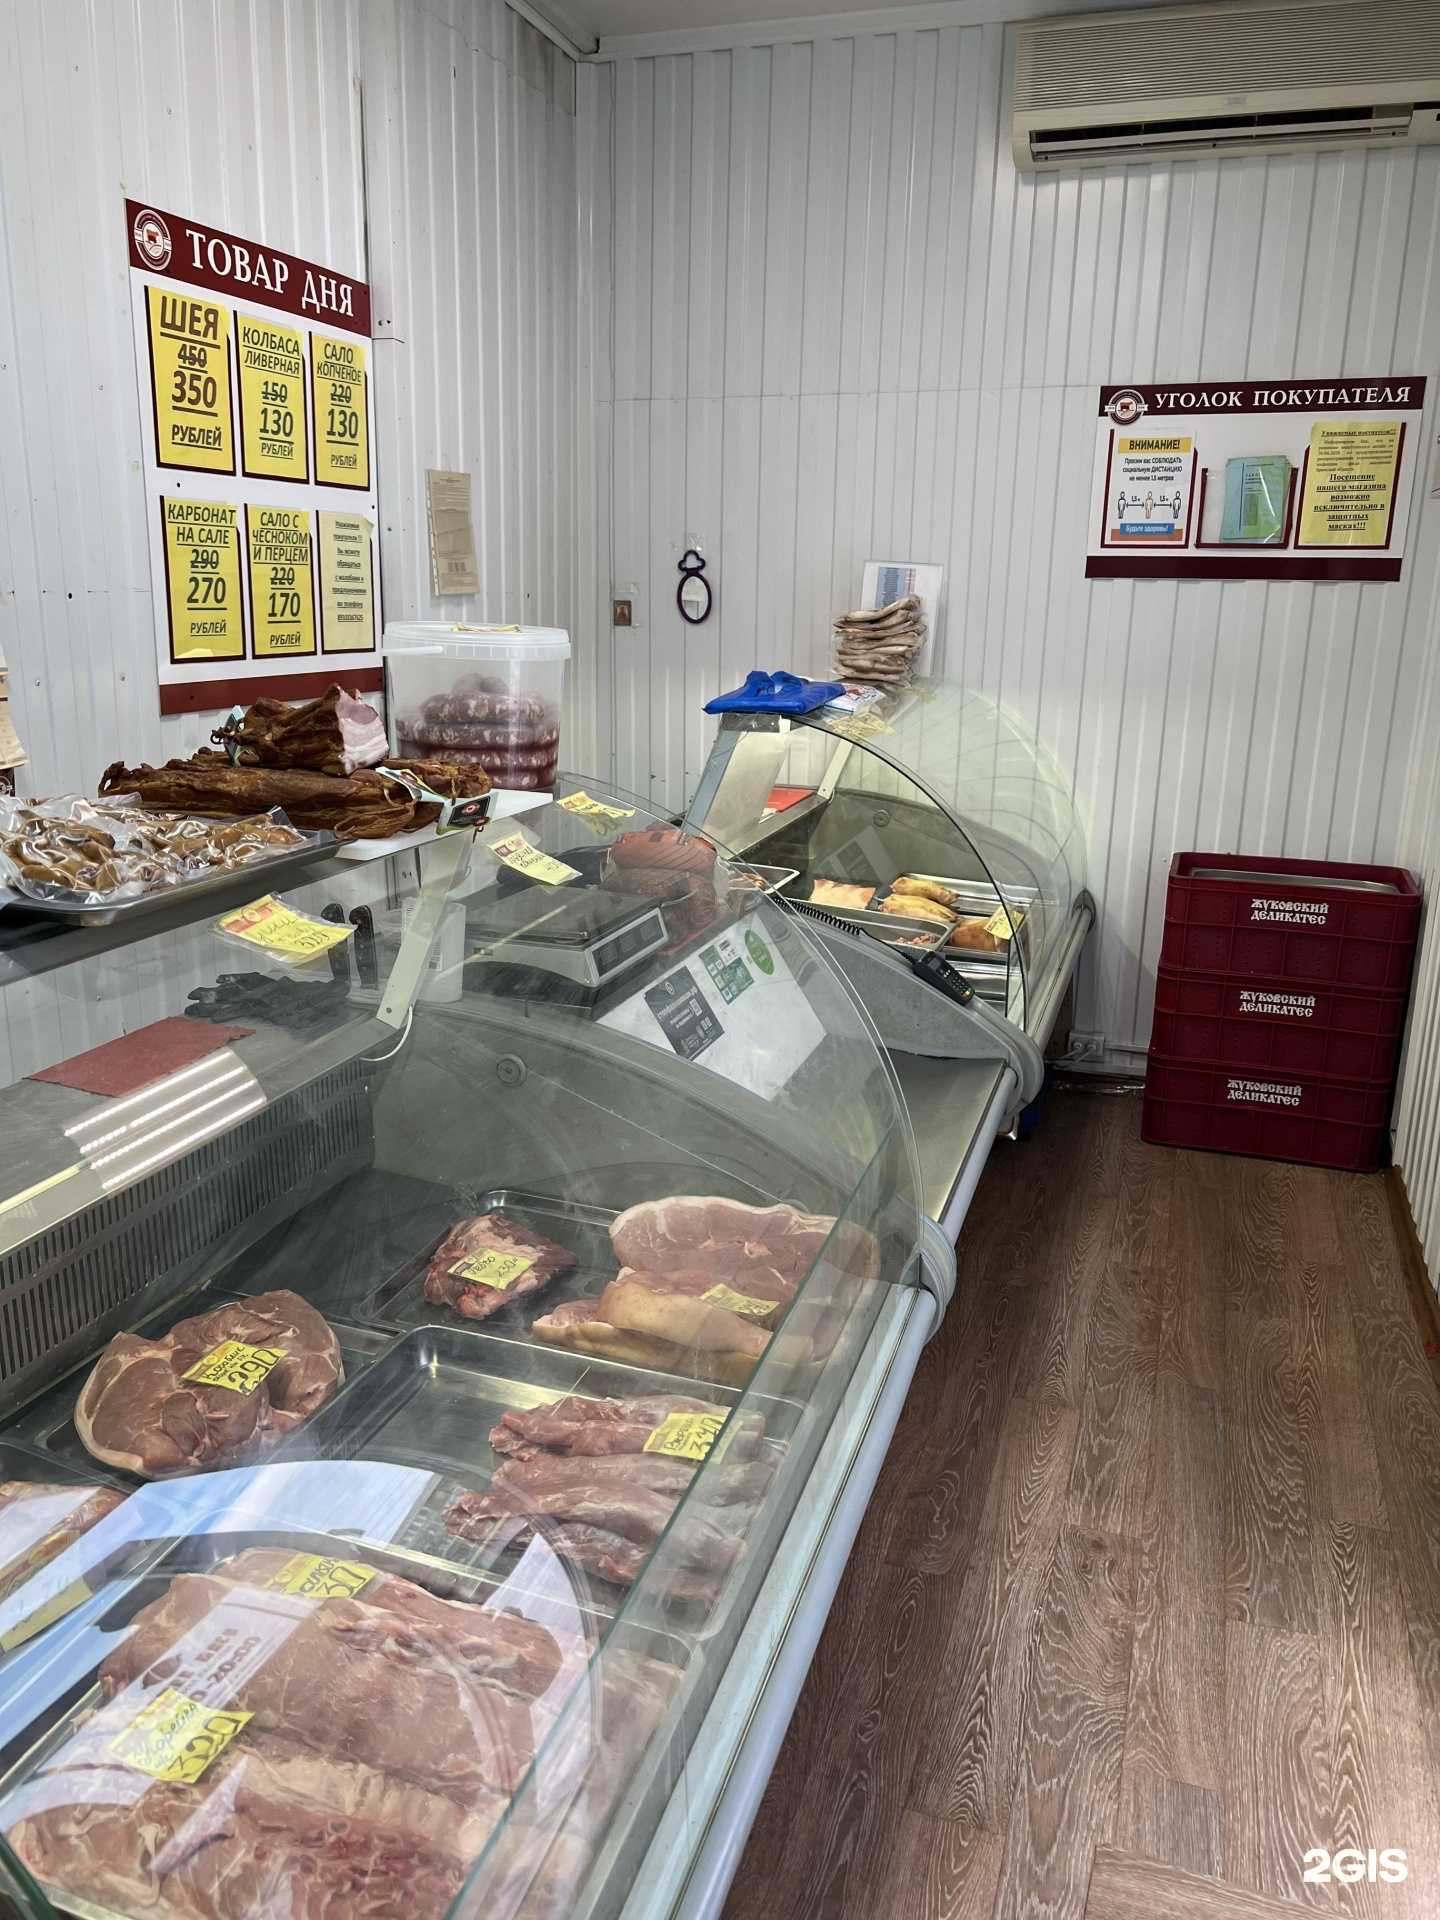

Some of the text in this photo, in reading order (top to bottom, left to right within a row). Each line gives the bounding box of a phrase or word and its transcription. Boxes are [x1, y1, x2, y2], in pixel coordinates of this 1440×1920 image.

[186, 229, 289, 293] ТОВАР
[301, 270, 354, 317] ДНЯ
[160, 295, 219, 340] ШЕЯ
[242, 326, 300, 357] КОЛБАСА
[177, 344, 207, 368] 450
[244, 350, 300, 375] ЛИВЕРНАЯ
[324, 342, 354, 364] САЛО
[317, 362, 362, 383] КОПЧЕНОЕ
[171, 370, 217, 408] 350
[261, 381, 288, 403] 150
[1155, 391, 1242, 410] УГОЛОК
[1253, 386, 1410, 408] ПОКУПАТЕЛЯ
[259, 408, 293, 437] 130
[326, 408, 359, 438] 130
[171, 424, 222, 448] РУБЛЕЙ
[1129, 440, 1180, 450] ВНИМАНИЕ!
[261, 440, 293, 458] РУБЛЕЙ
[331, 454, 357, 466] РУБЛЕЙ
[168, 503, 236, 525] КАРБОНАТ
[260, 511, 299, 528] САЛО С
[177, 527, 230, 545] НА САЛЕ
[252, 531, 308, 546] ЧЕСНОКОМ
[190, 548, 219, 570] 290
[253, 547, 308, 564] И ПЕРЦЕМ
[270, 566, 295, 586] 220
[187, 576, 227, 604] 270
[267, 593, 301, 618] 170
[190, 620, 227, 635] РУБЛЕЙ
[270, 632, 301, 646] РУБЛЕЙ
[1250, 898, 1329, 914] ЖУКОВСКИЙ
[1240, 990, 1316, 1007] ЖУКОВСКИЙ
